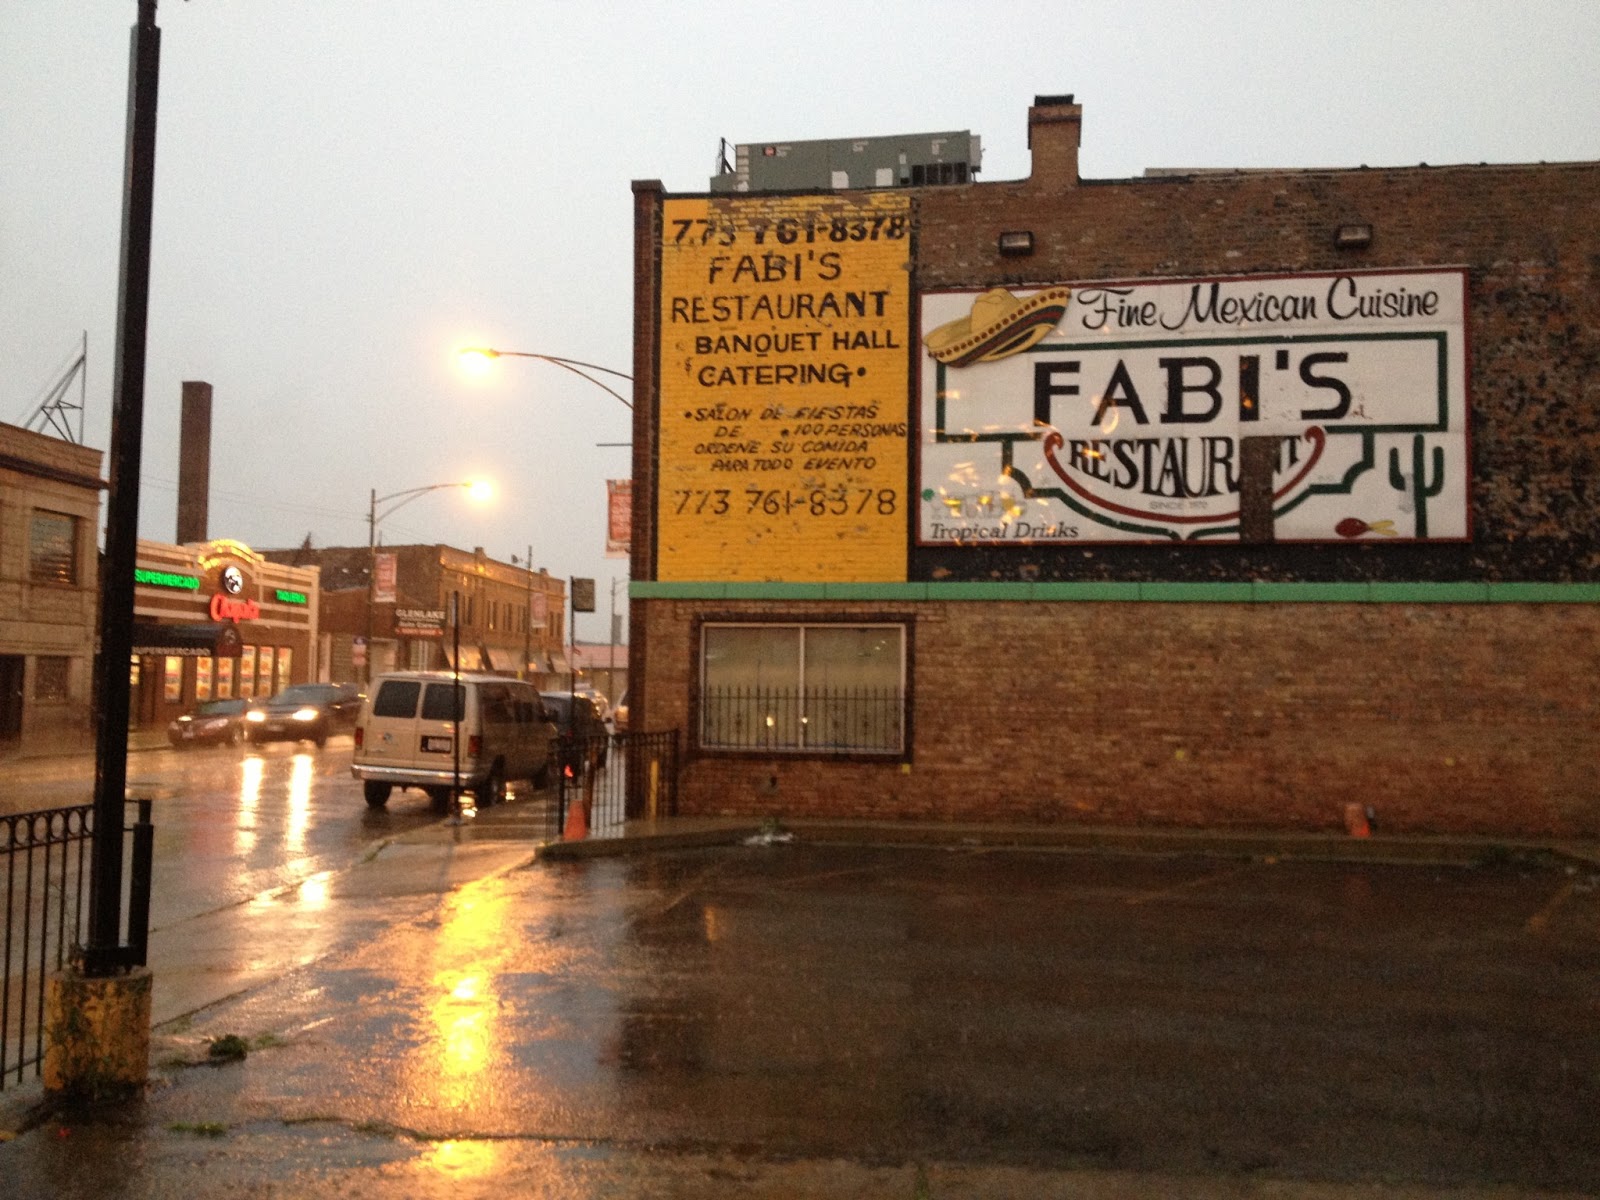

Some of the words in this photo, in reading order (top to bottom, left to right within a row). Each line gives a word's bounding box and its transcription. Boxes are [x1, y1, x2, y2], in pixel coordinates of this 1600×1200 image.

[708, 250, 842, 284] FABI'S
[671, 290, 891, 324] RESTAURANT
[1077, 287, 1157, 330] Fine
[1160, 282, 1318, 330] Mexican
[1327, 276, 1439, 320] Cuisine
[695, 332, 822, 357] BANQUET
[833, 329, 900, 350] HALL
[697, 362, 853, 388] CATERING
[1033, 350, 1352, 426] FABI'S
[760, 408, 783, 421] DE
[792, 404, 880, 421] FIESTAS
[714, 426, 742, 438] DE
[694, 441, 762, 455] ORDENE
[771, 441, 794, 453] SU
[801, 440, 869, 453] COMIDA
[804, 456, 877, 471] EVENTO
[674, 488, 732, 516] 773
[745, 488, 897, 517] 761-8378
[930, 522, 1008, 542] Tropical
[1013, 521, 1079, 539] Drinks
